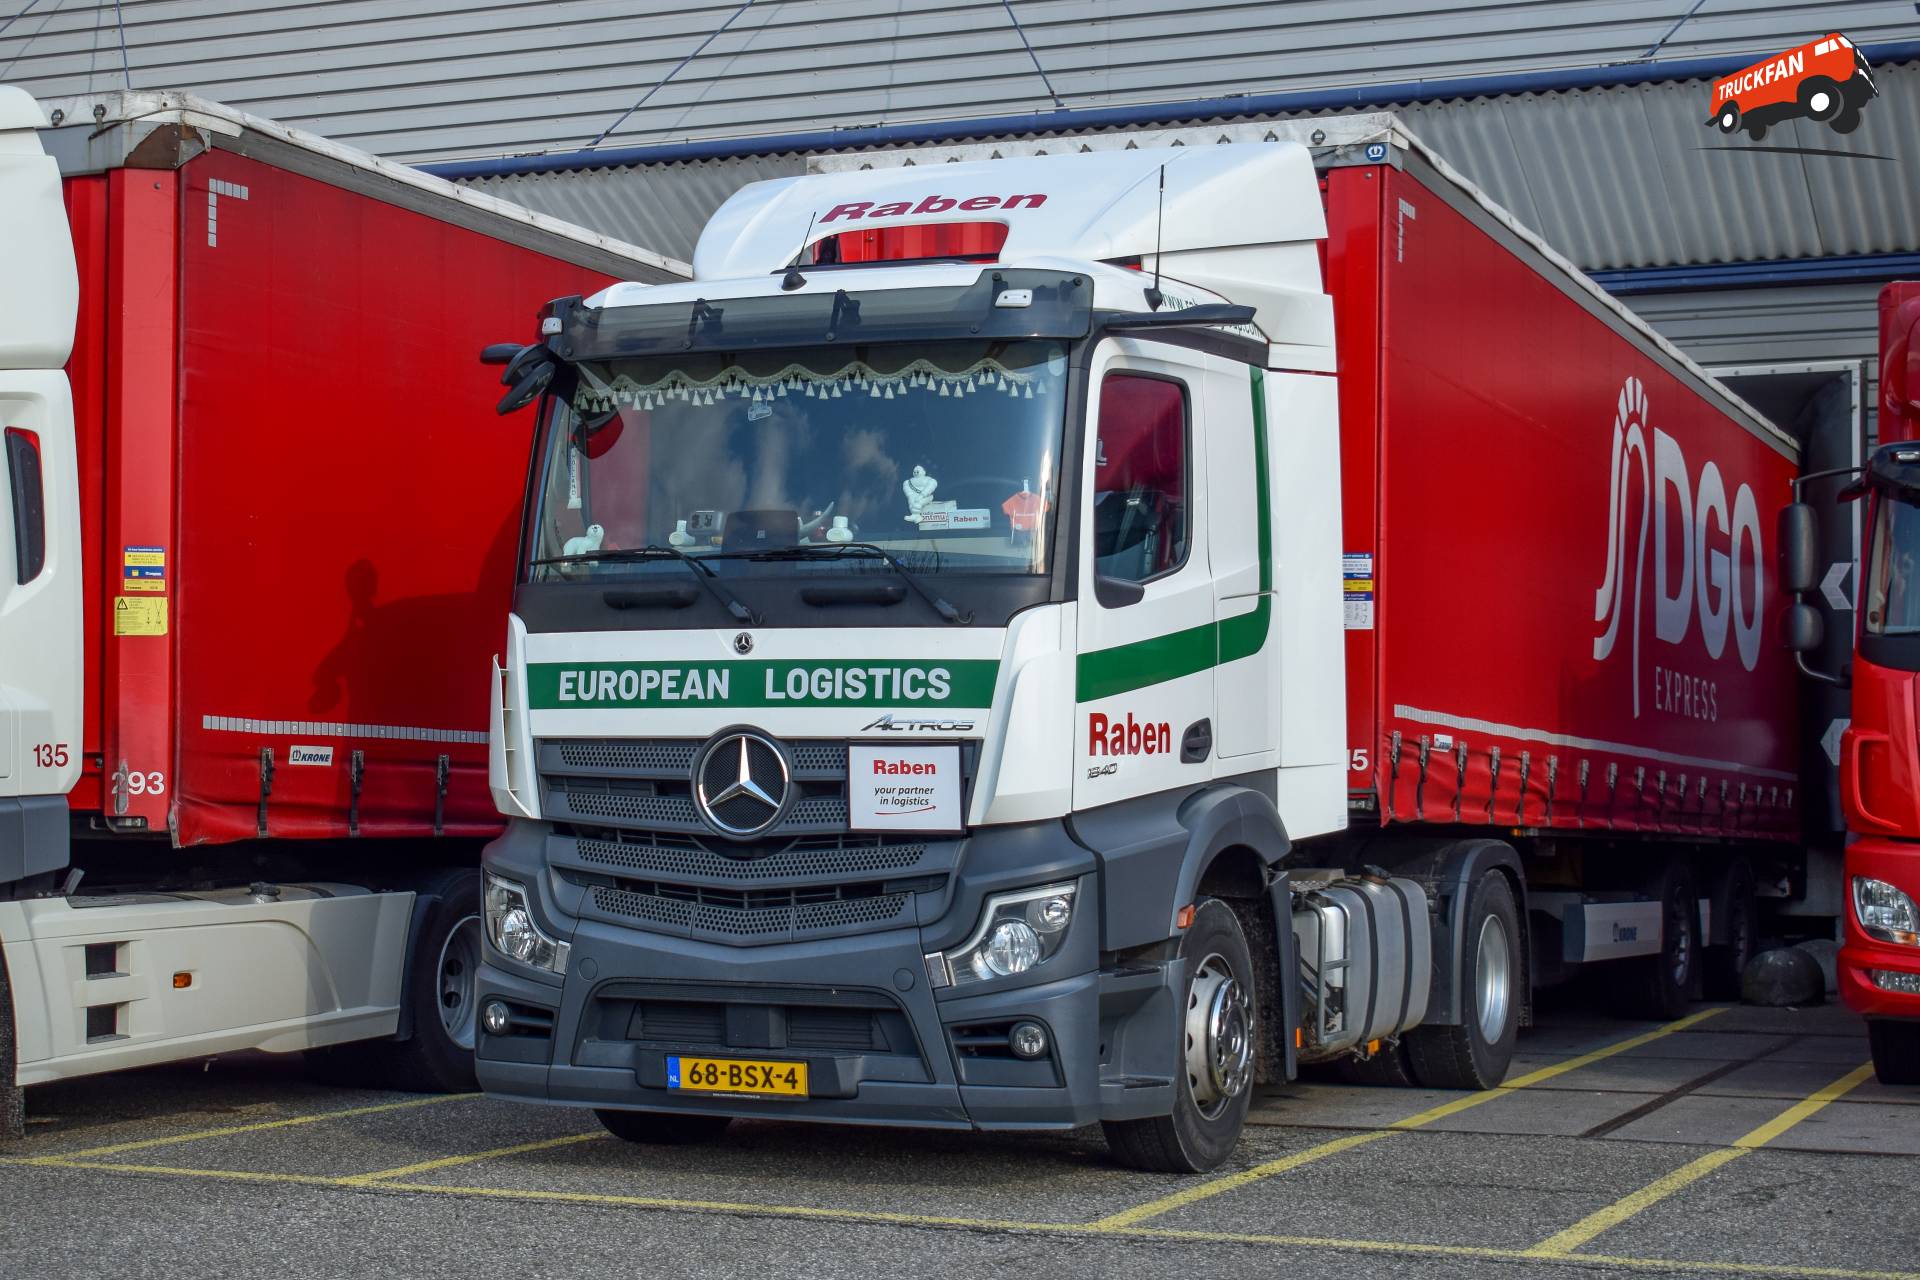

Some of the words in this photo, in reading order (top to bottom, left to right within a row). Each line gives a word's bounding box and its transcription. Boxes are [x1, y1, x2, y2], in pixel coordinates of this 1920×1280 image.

[818, 193, 1048, 223] Raben
[558, 668, 730, 701] EUROPEAN
[765, 667, 951, 700] LOGISTICS
[1655, 666, 1718, 722] EXPRESS
[1088, 712, 1171, 757] Raben
[33, 743, 69, 768] 135
[301, 753, 331, 762] KRONE
[873, 759, 936, 775] Raben
[874, 786, 896, 796] your
[898, 786, 935, 795] partner
[879, 797, 889, 805] in
[891, 796, 929, 807] logistics
[669, 1075, 680, 1083] NL
[689, 1062, 799, 1090] 68-BSX-4
